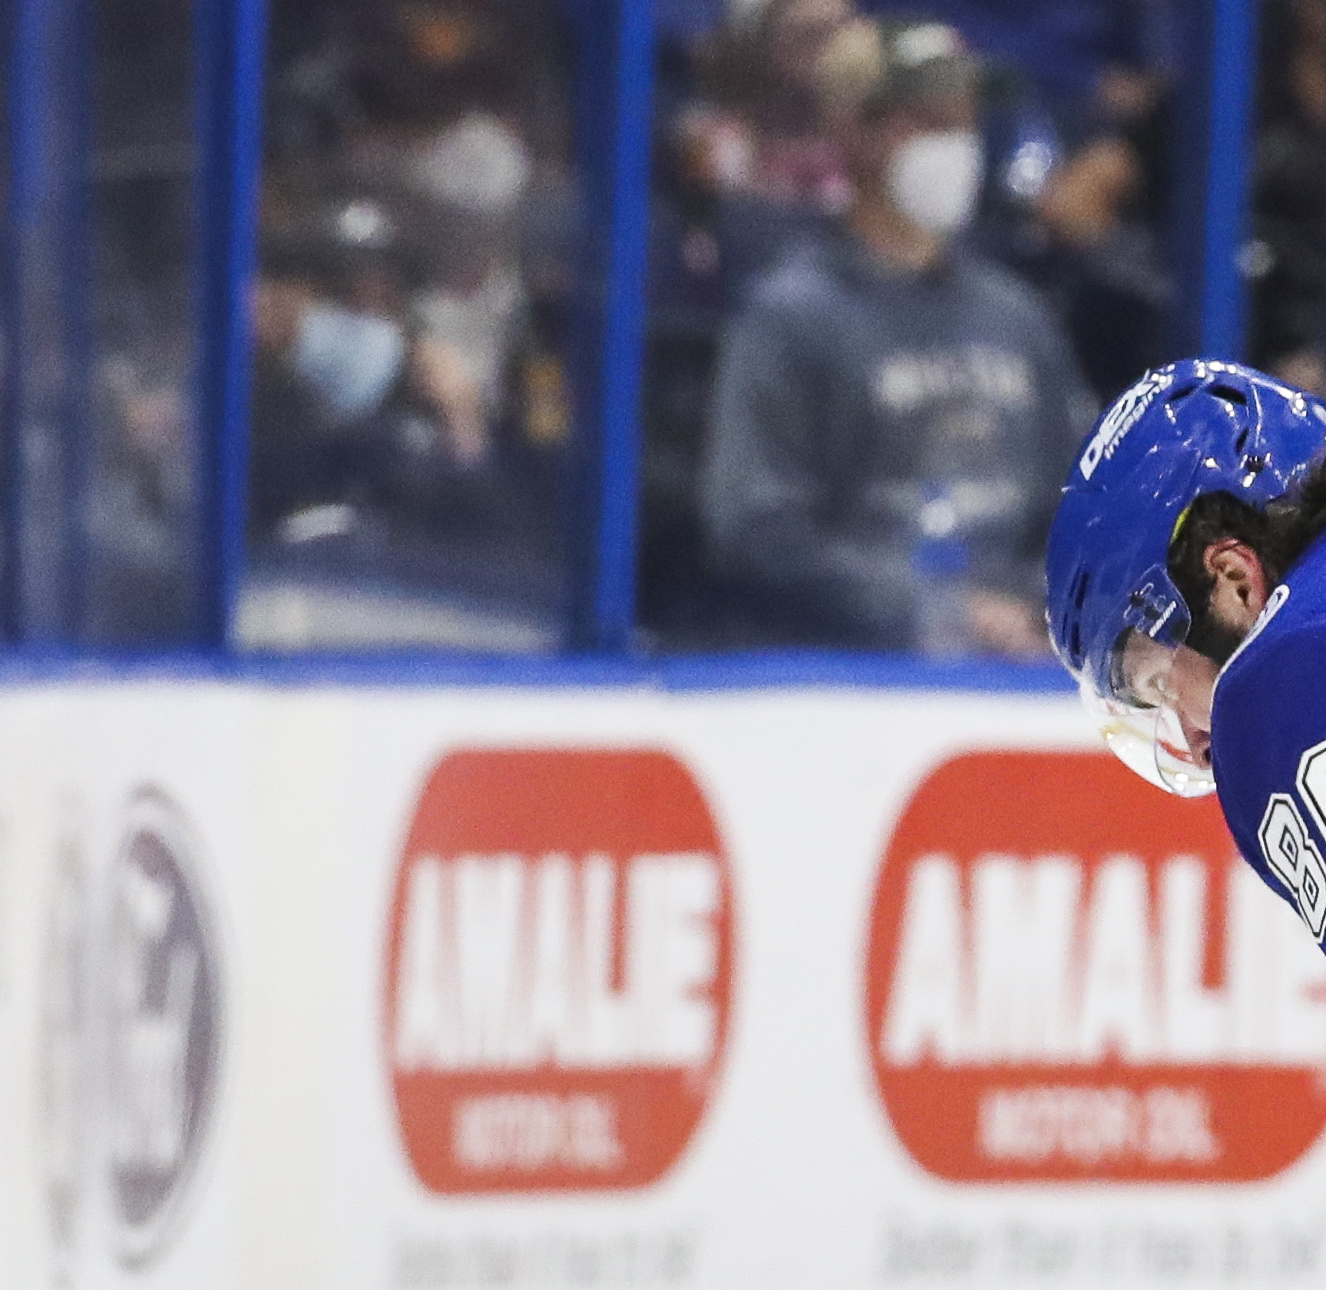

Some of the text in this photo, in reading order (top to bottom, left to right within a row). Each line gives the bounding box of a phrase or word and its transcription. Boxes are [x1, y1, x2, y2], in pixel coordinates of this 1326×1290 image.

[1079, 368, 1156, 481] DEX
[380, 850, 717, 1070] AMALIE
[977, 1086, 1133, 1162] MOTOR
